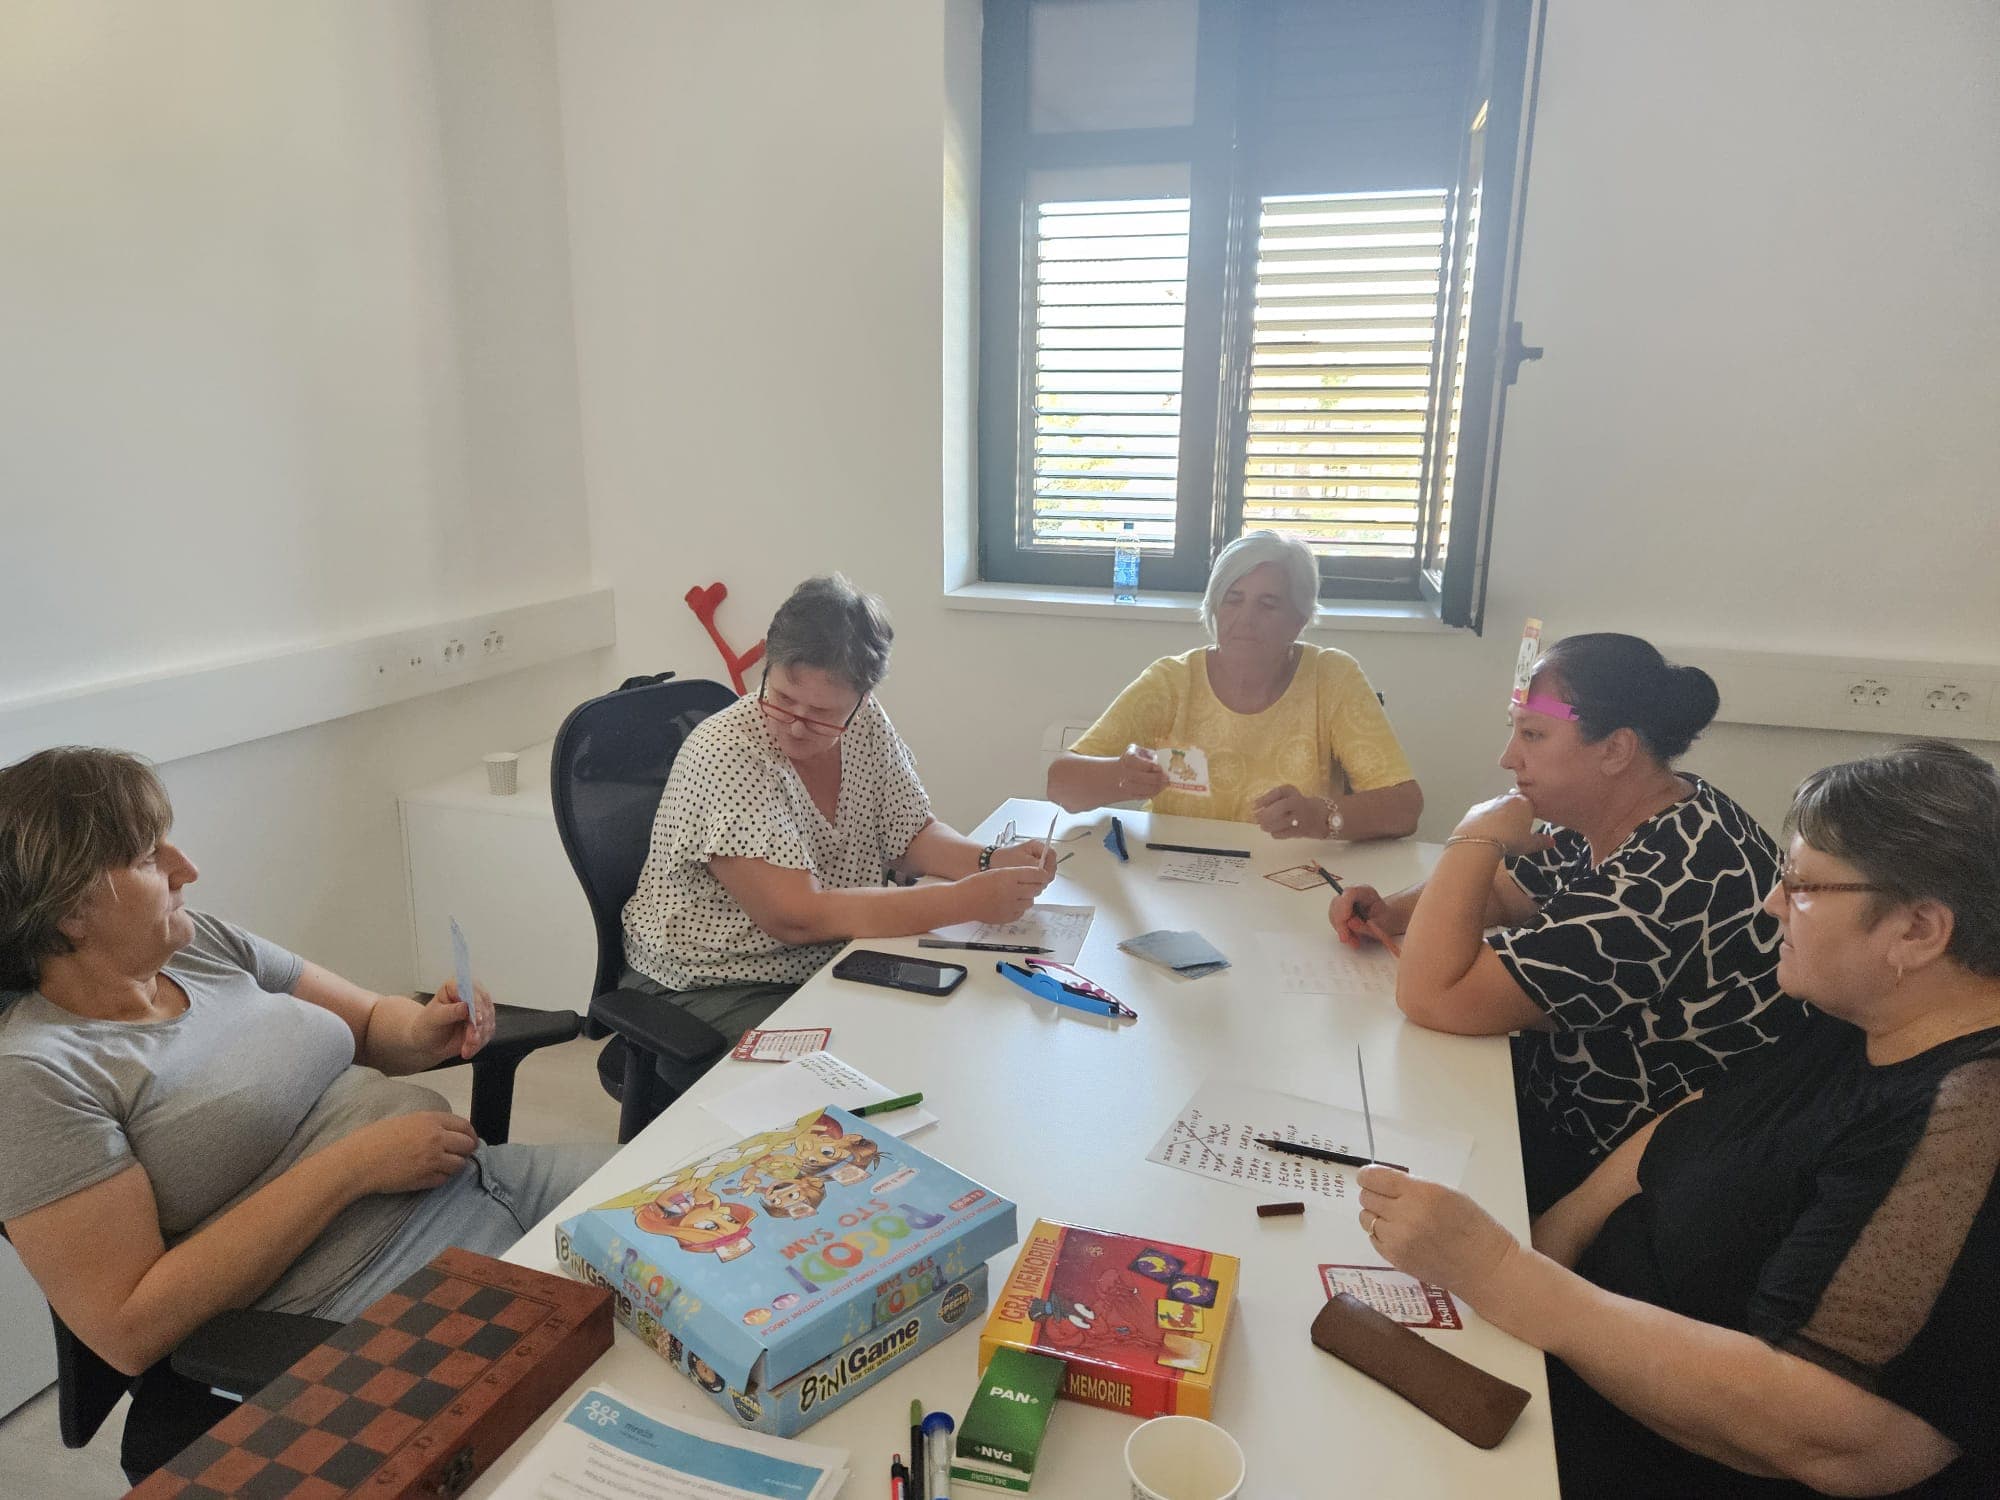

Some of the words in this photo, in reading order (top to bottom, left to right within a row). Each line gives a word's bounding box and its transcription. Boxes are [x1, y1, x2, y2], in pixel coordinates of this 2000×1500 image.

[785, 1202, 946, 1295] POGODI
[1013, 1236, 1057, 1296] MEMORIJE
[999, 1295, 1033, 1325] IGRA
[849, 1318, 920, 1375] Game
[1070, 1373, 1132, 1408] MEMORIJE
[981, 1447, 1012, 1462] PAN
